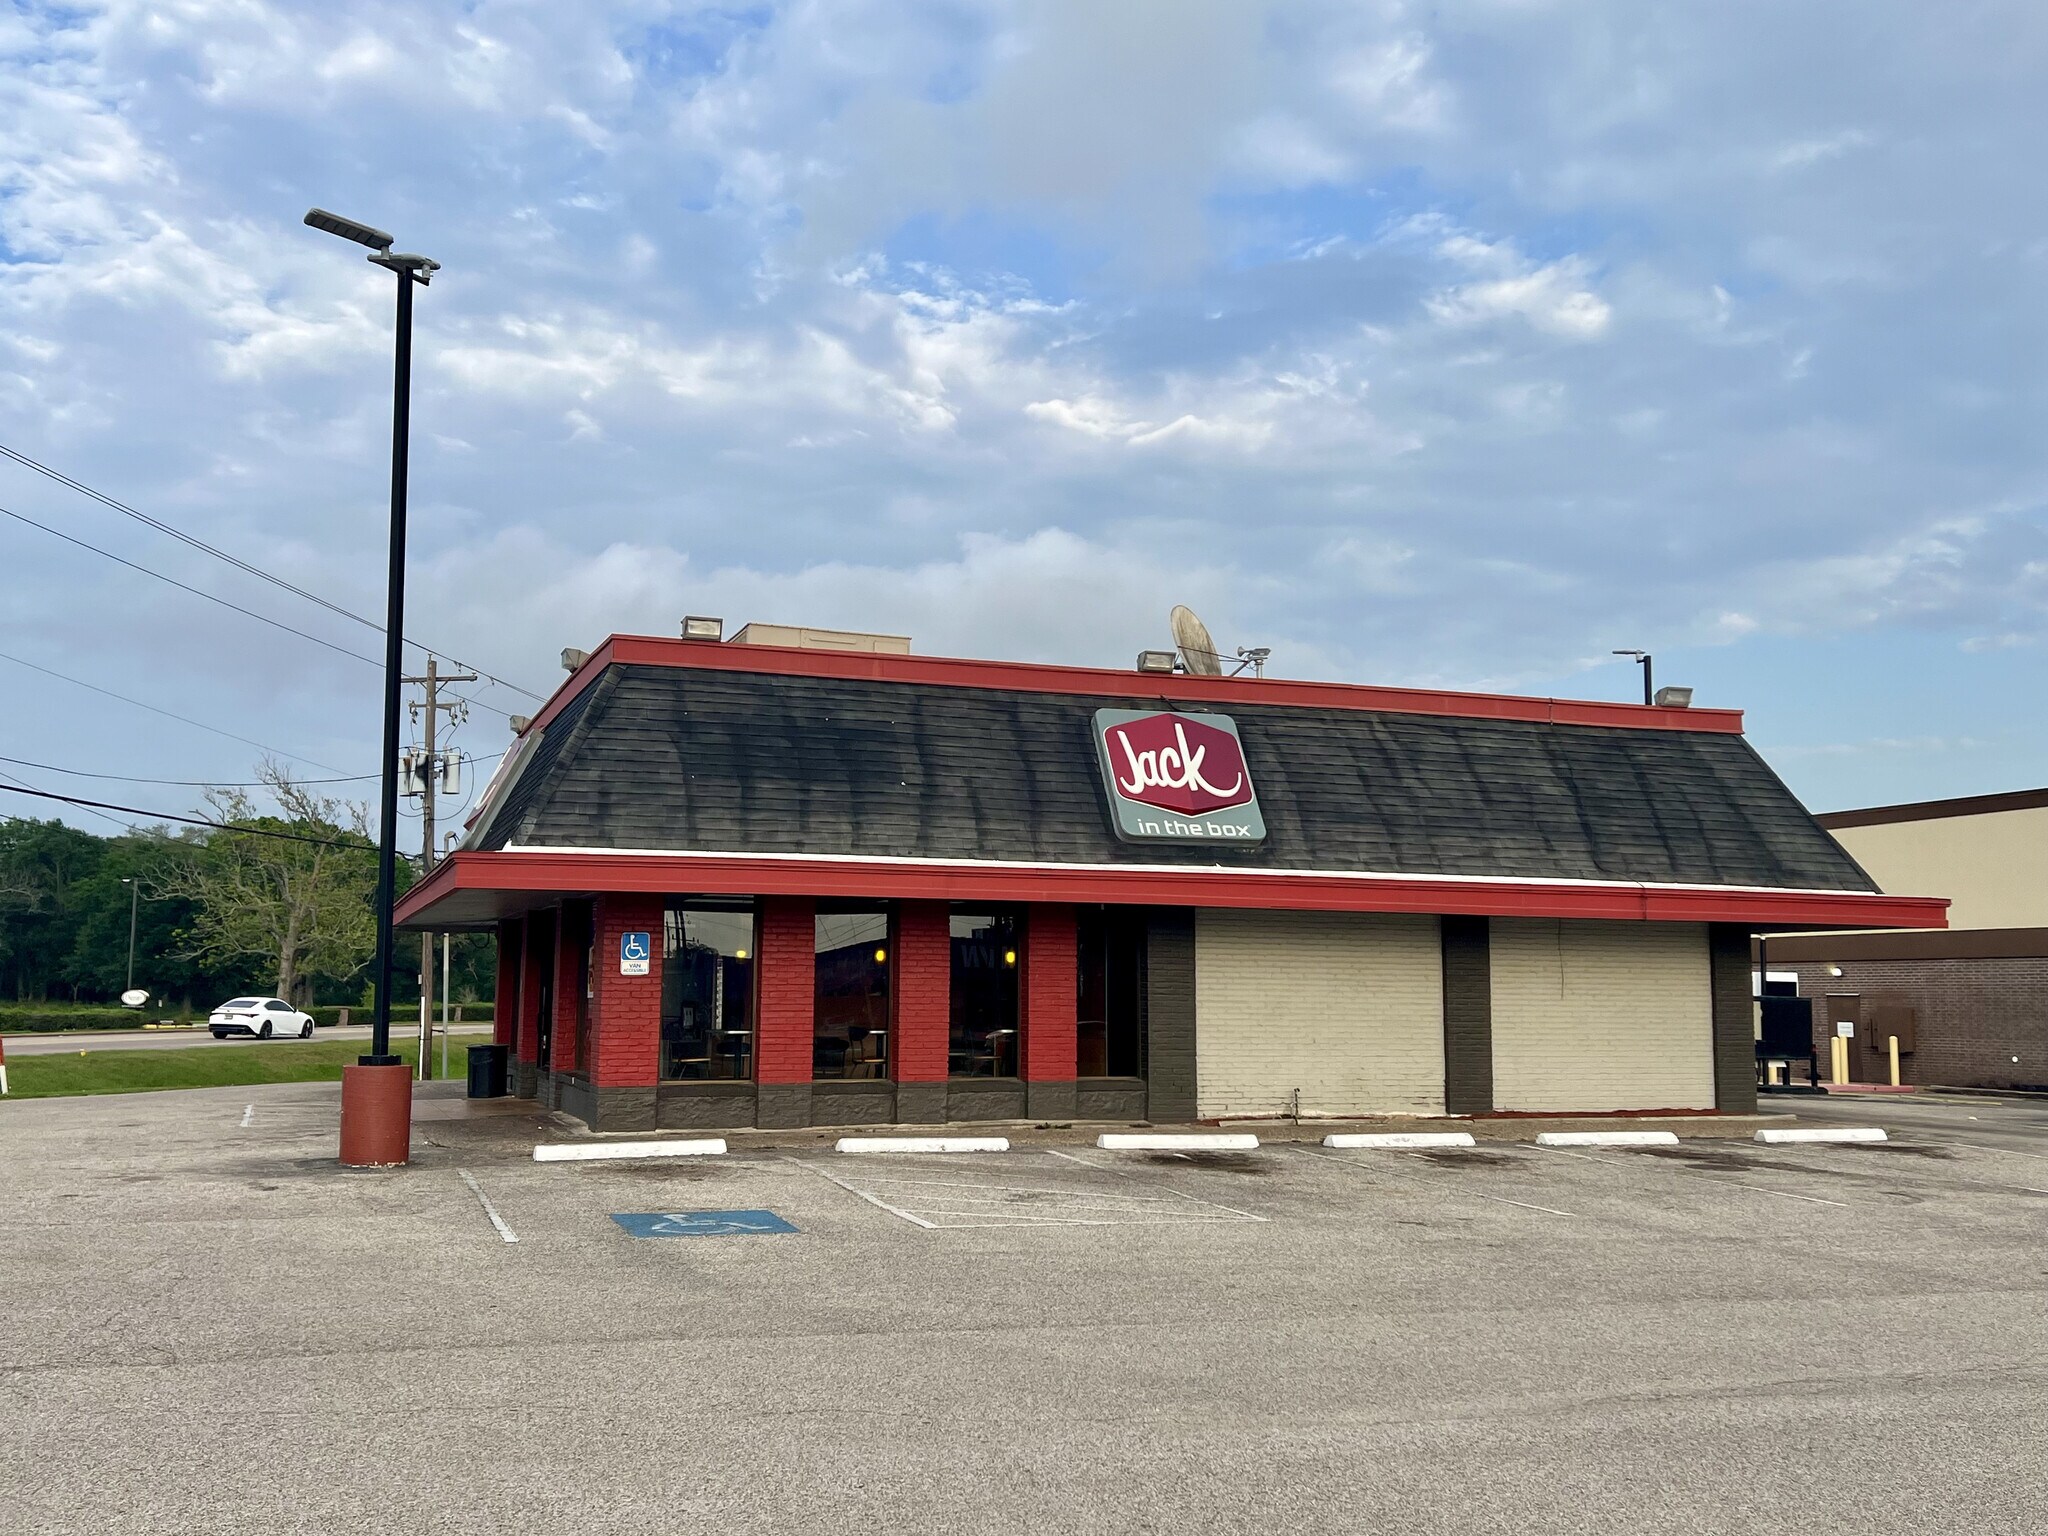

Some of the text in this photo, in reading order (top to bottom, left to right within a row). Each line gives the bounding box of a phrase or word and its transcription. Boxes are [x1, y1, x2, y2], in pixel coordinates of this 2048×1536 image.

[1117, 723, 1242, 798] Jack
[1138, 819, 1250, 837] in the box
